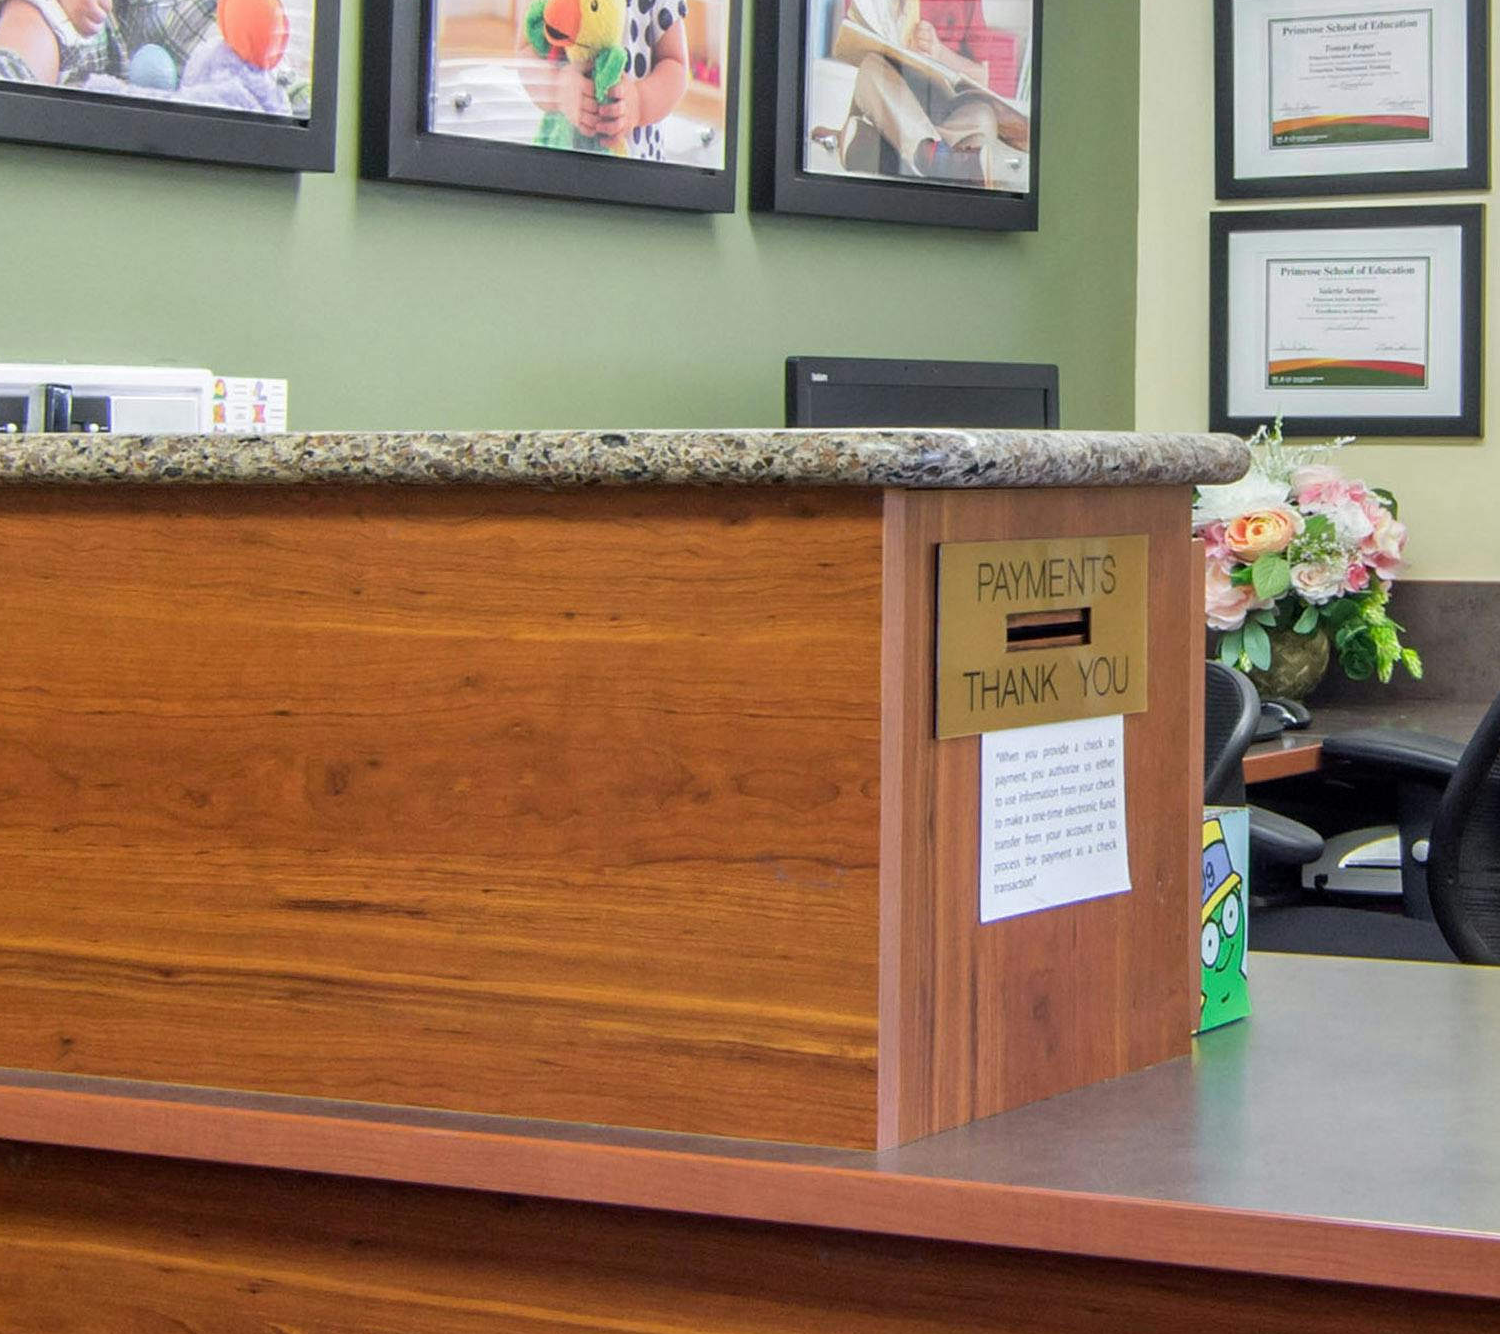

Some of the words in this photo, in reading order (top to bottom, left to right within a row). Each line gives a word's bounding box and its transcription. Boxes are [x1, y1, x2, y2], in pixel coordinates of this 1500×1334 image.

[1326, 22, 1356, 33] School
[1358, 22, 1368, 31] of
[1371, 19, 1418, 30] Education
[1280, 267, 1321, 276] Primrose
[1324, 266, 1354, 276] School
[1356, 266, 1366, 275] of
[1368, 266, 1416, 275] Education
[978, 555, 1116, 602] PAYMENTS
[963, 663, 1059, 712] THANK
[1078, 656, 1129, 698] YOU
[1025, 750, 1038, 763] you
[1043, 744, 1069, 759] provide
[1074, 743, 1079, 753] a
[1084, 739, 1103, 750] check
[1031, 770, 1044, 783] you
[1048, 764, 1079, 777] authorize
[1096, 758, 1115, 770] either
[995, 797, 1002, 807] to
[1004, 795, 1017, 805] use
[1019, 788, 1059, 802] information
[1060, 784, 1077, 795] from
[1078, 783, 1094, 796] your
[1095, 776, 1115, 790] check
[995, 819, 1002, 829] to
[1004, 815, 1023, 826] make
[1025, 814, 1030, 823] a
[1064, 802, 1098, 816] electronic
[1099, 797, 1116, 810] fund
[995, 835, 1021, 851] transfer
[1025, 833, 1042, 844] from
[1046, 830, 1061, 843] your
[1066, 823, 1093, 837] account
[1097, 822, 1104, 831] or
[1108, 820, 1117, 829] to
[994, 860, 1021, 875] process
[1025, 853, 1037, 866] the
[1041, 848, 1072, 865] payment
[1088, 845, 1093, 854] a
[1096, 838, 1117, 852] check
